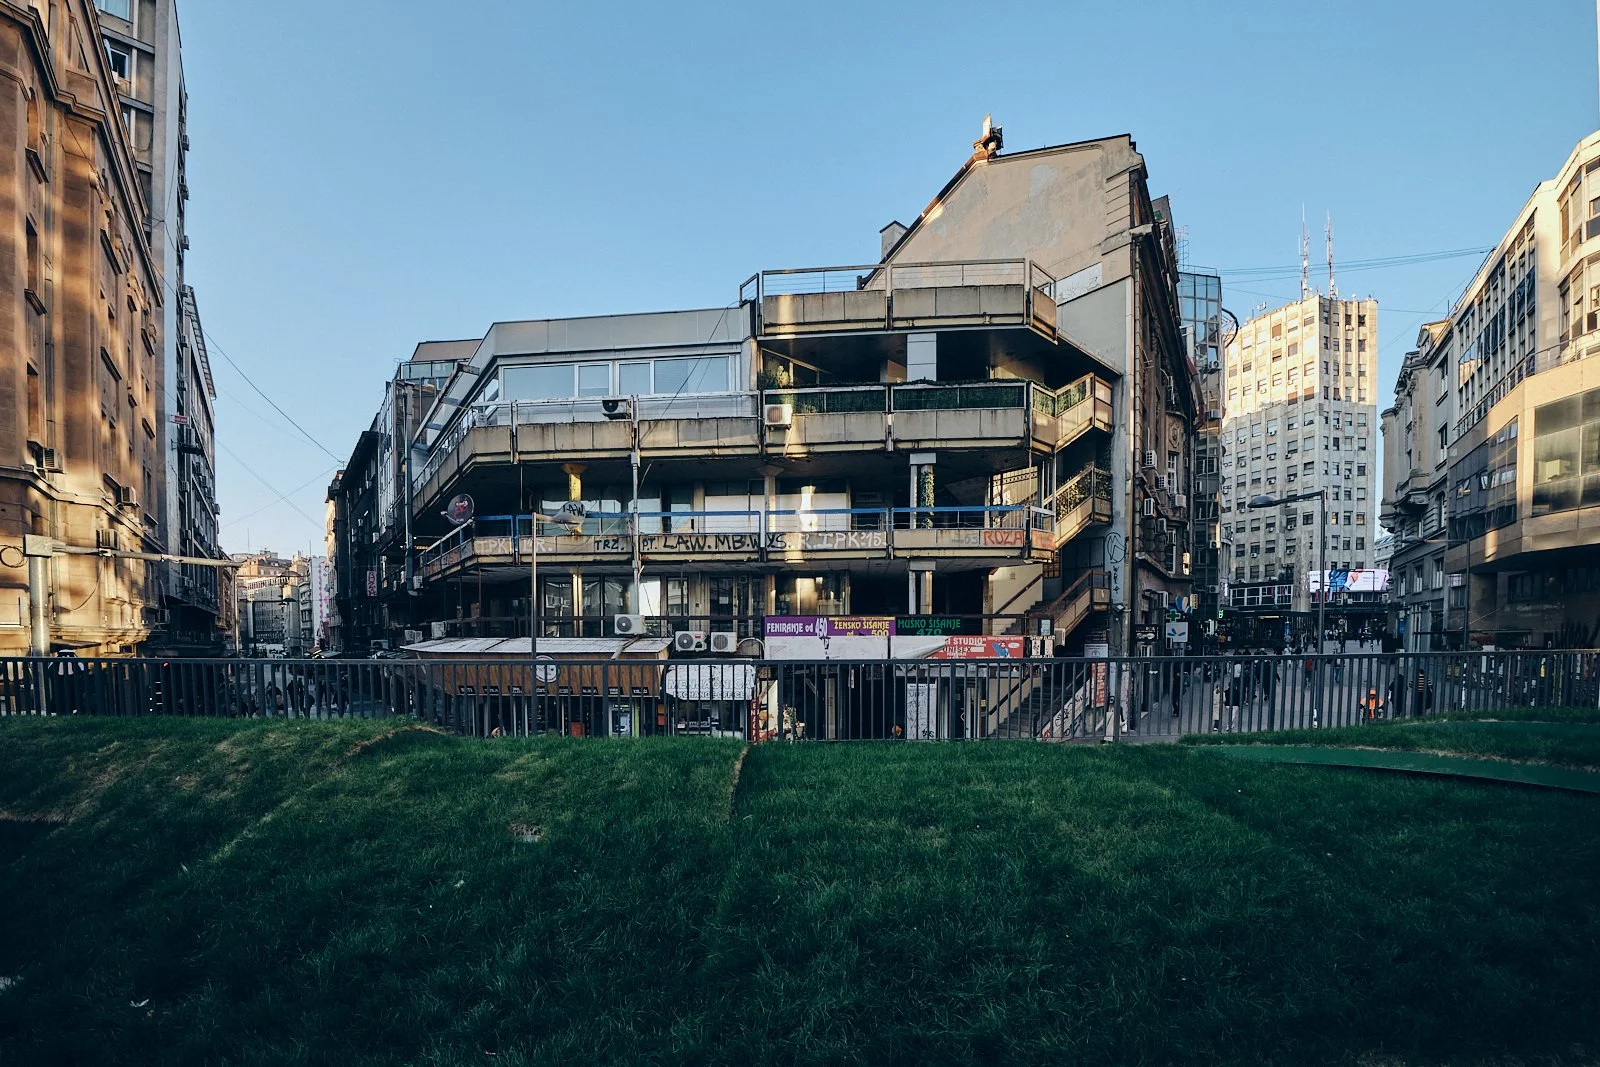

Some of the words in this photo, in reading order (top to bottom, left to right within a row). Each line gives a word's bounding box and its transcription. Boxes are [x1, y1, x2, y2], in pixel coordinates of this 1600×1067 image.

[766, 622, 804, 635] FENIRANJE
[834, 620, 861, 630] ŽENSKO
[862, 620, 890, 631] ŠIŠANJE
[897, 618, 926, 629] MUŠKO
[928, 617, 961, 629] ŠIŠANJE
